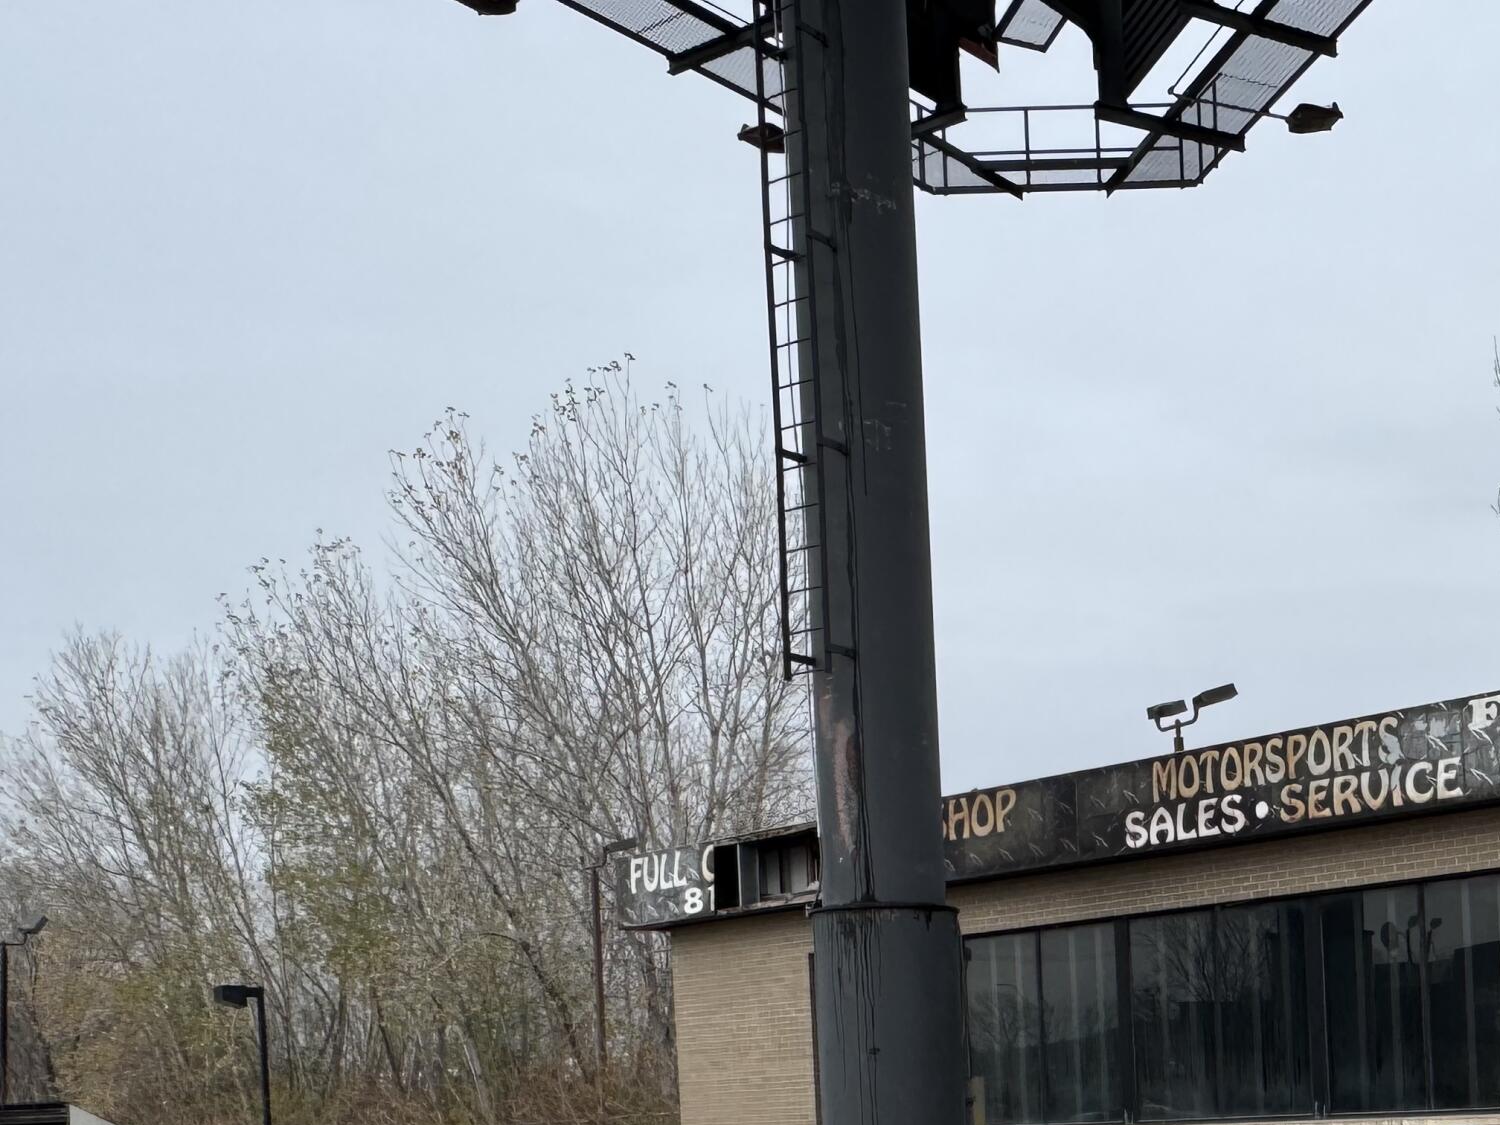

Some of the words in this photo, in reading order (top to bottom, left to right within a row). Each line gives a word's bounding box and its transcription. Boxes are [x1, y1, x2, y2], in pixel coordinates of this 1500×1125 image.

[1152, 716, 1400, 803] MOTORSPORTS
[943, 789, 1016, 840] HOP
[1125, 794, 1246, 848] SALES
[1280, 756, 1462, 823] SERVICE
[630, 850, 687, 894] FULL
